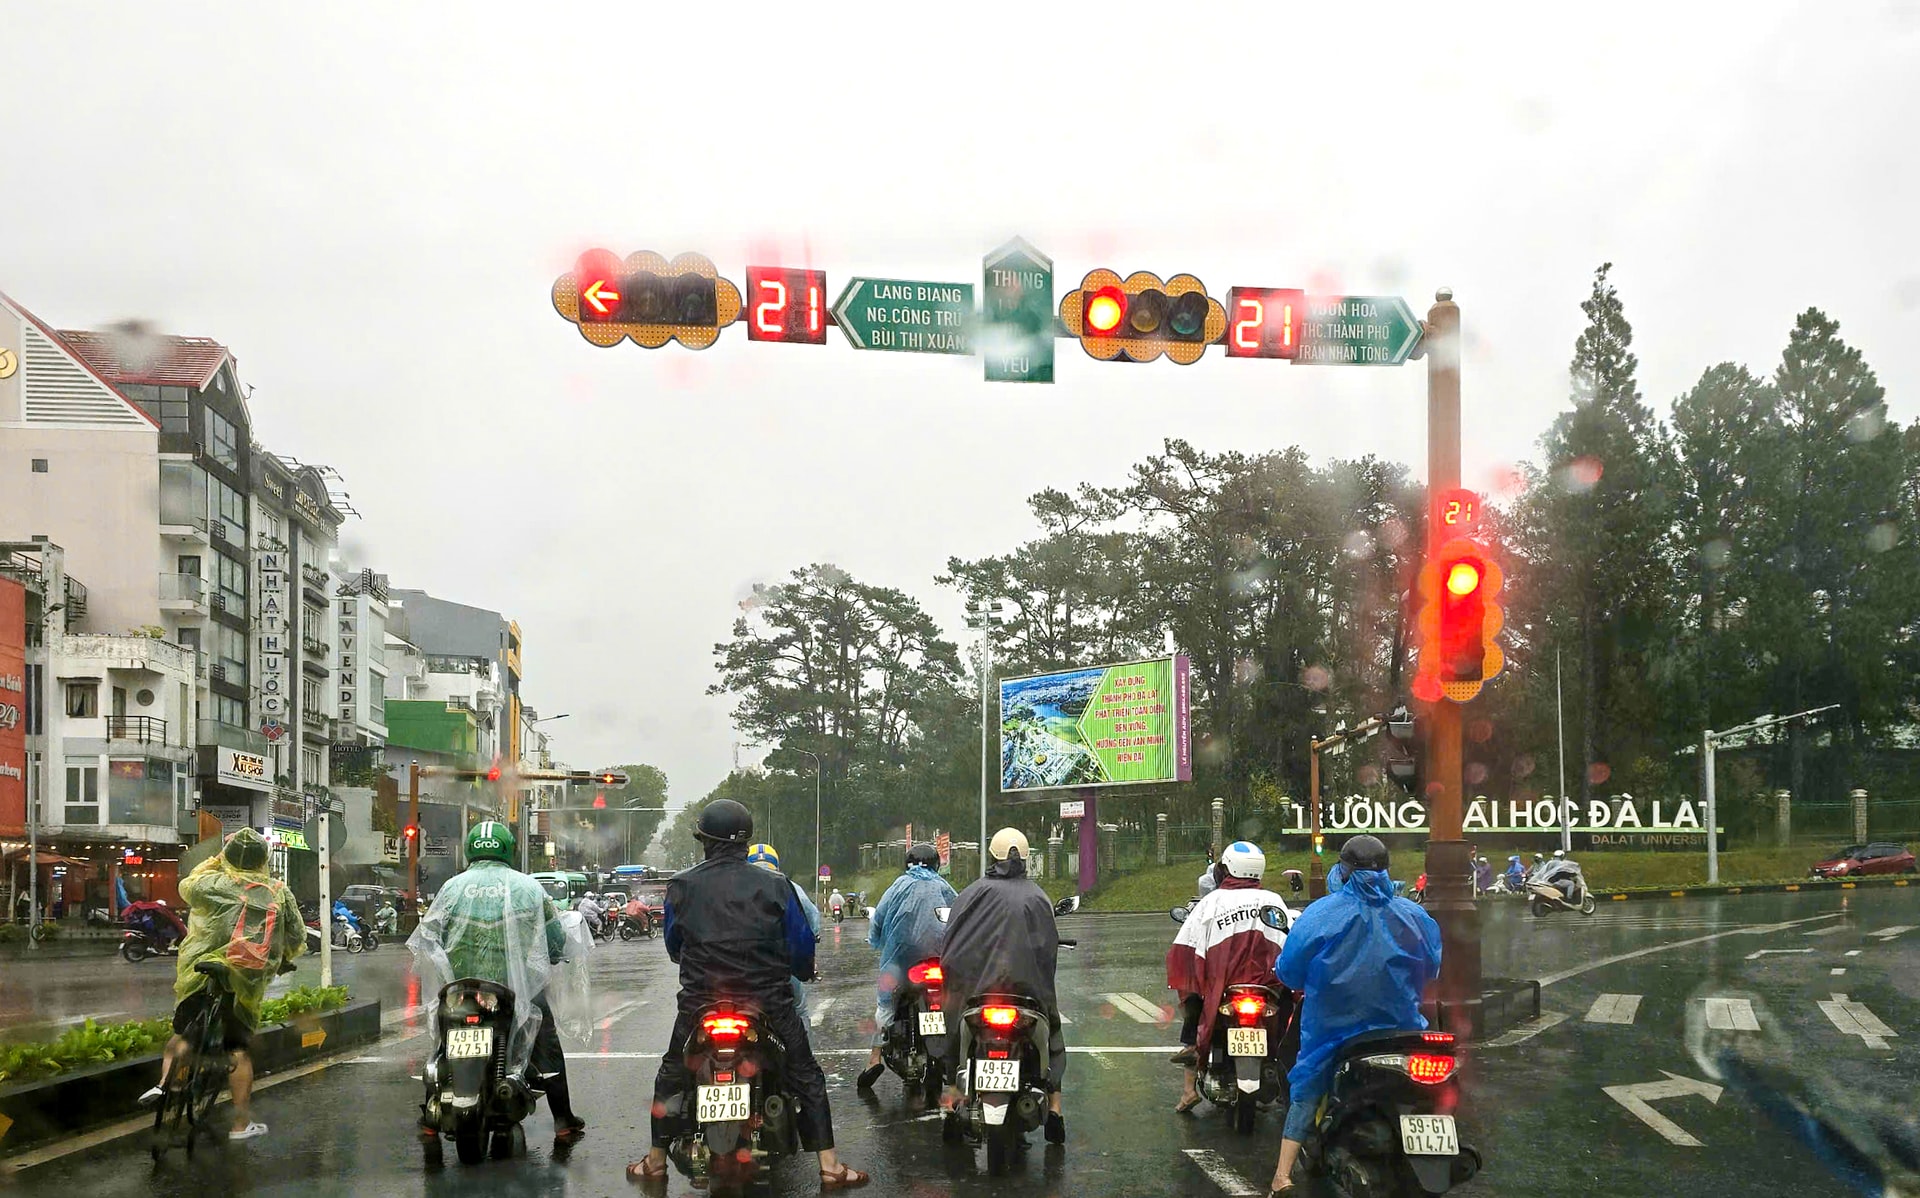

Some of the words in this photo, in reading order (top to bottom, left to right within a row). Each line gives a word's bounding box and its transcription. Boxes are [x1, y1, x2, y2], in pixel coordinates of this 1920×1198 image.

[873, 284, 912, 301] LANG
[917, 287, 962, 303] BIANG
[757, 280, 818, 332] 21
[1352, 303, 1378, 318] HOA
[867, 306, 931, 325] NG.CÔNG
[1235, 299, 1292, 348] 21
[872, 326, 896, 346] BÙI
[900, 331, 922, 351] THỊ
[927, 331, 966, 350] XUÂN
[1368, 321, 1392, 340] PHỐ
[1329, 342, 1358, 360] NHÂN
[1361, 343, 1390, 361] TÔNG
[1445, 501, 1472, 525] 21
[1291, 794, 1426, 829] TƯỜNG
[1462, 798, 1499, 832] ẠI
[1588, 793, 1642, 828] ĐÀ
[473, 839, 500, 849] Grab
[1592, 835, 1634, 845] DALAT
[1641, 834, 1707, 846] UNIVERSIT
[463, 881, 511, 899] Grab
[453, 1029, 486, 1044] 49-B1
[1234, 1030, 1261, 1042] 49-B1
[448, 1042, 490, 1056] 247.51
[1231, 1042, 1265, 1055] 385.13
[977, 1075, 1016, 1089] 022.24
[705, 1087, 742, 1102] 49-AD
[700, 1102, 747, 1119] 087.06
[1408, 1118, 1446, 1134] 59-G1
[1406, 1135, 1455, 1152] 014.74
